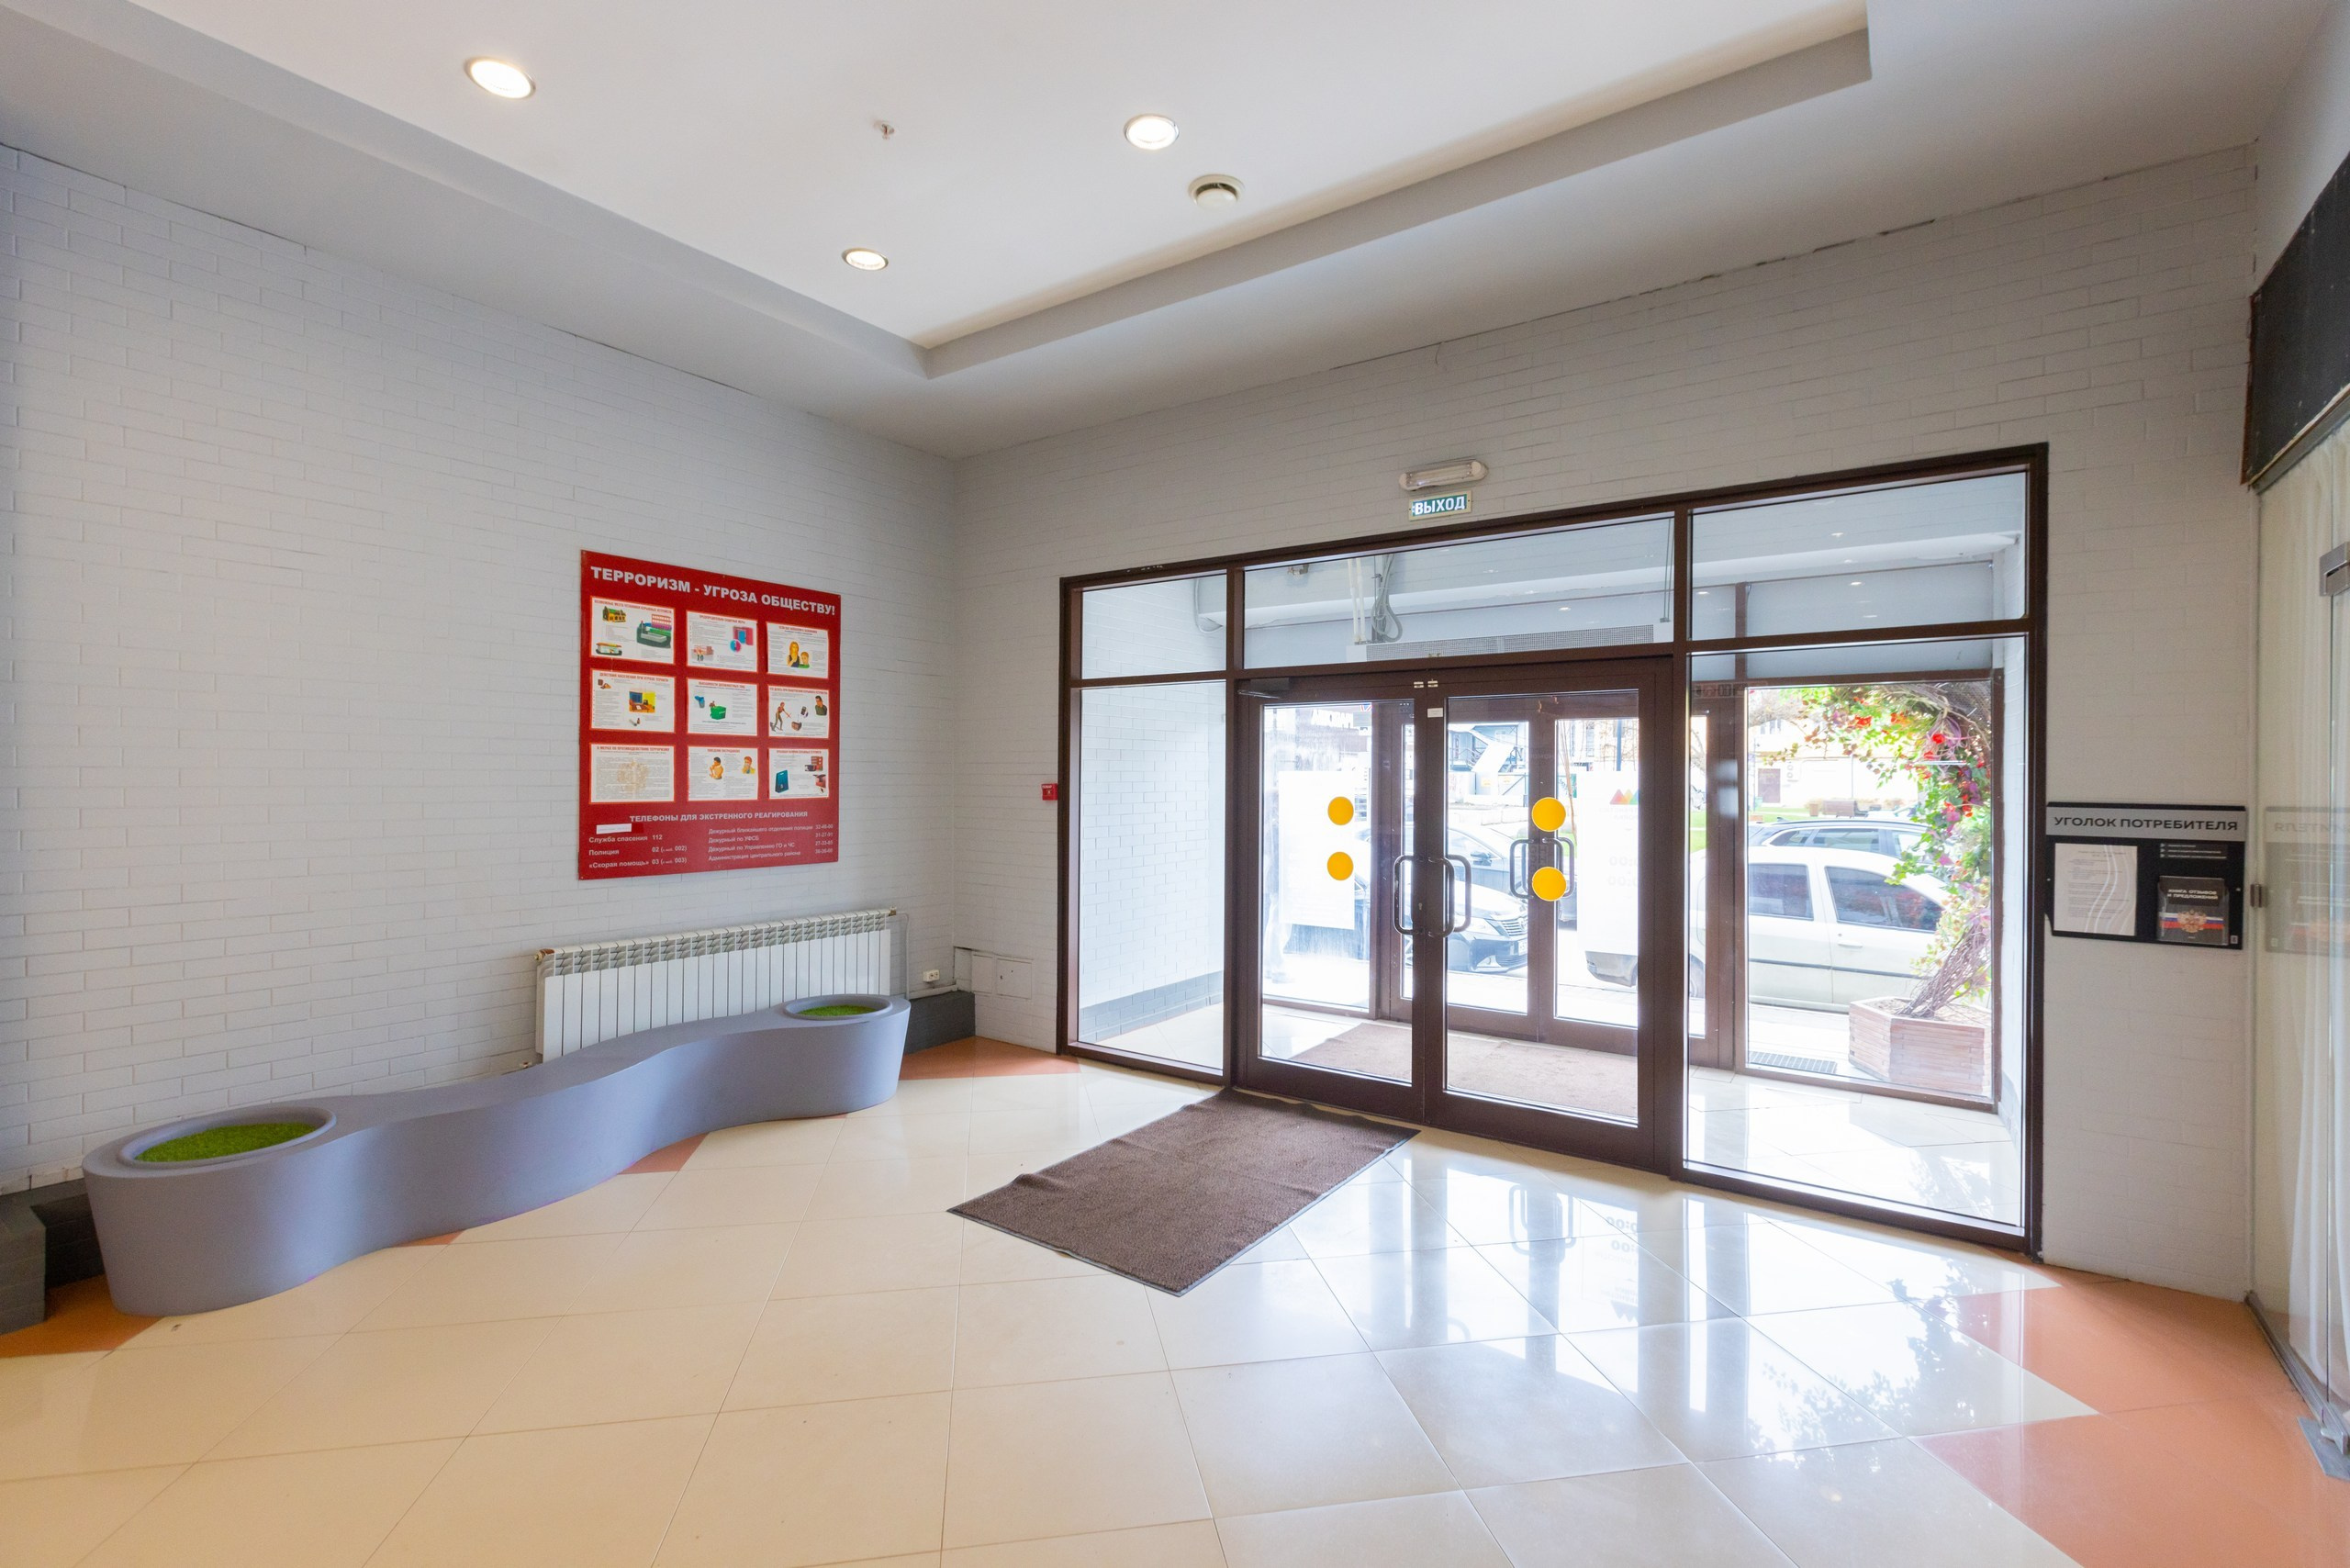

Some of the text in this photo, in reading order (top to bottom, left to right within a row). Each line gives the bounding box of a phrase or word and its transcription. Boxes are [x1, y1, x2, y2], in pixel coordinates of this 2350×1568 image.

[1415, 496, 1465, 515] ВЫХОД
[590, 566, 690, 593] ТЕРРОРИЗМ
[703, 584, 757, 603] УГРОЗА
[761, 594, 835, 616] ОБЩЕСТВУ!
[2054, 817, 2238, 831] УГОЛОК ПОТРЕБИТЕЛЯ
